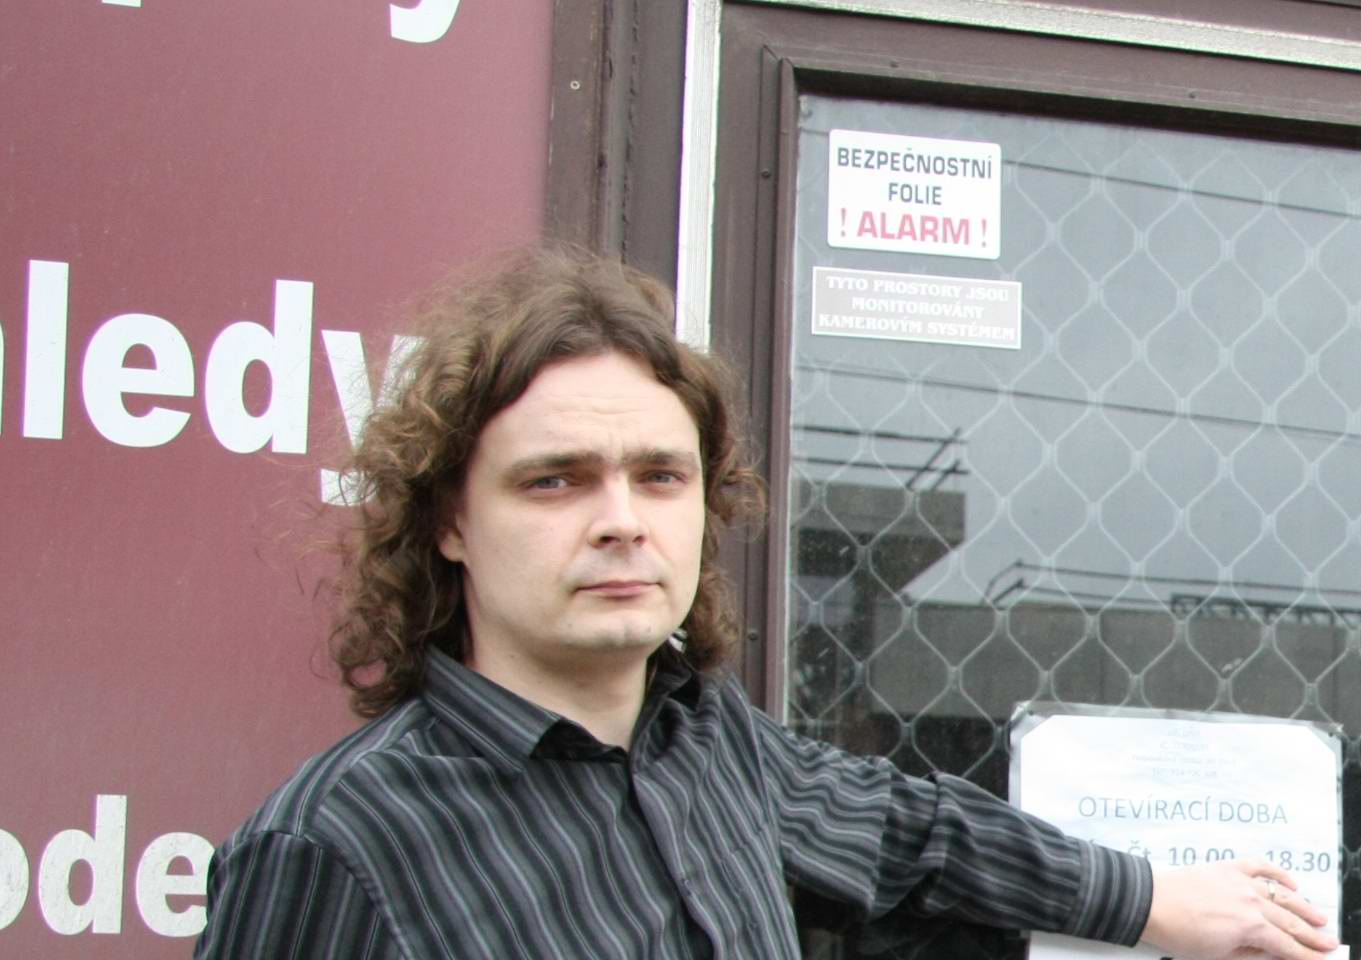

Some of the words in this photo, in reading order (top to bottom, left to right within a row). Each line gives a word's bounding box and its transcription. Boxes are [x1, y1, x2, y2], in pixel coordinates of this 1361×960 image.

[837, 147, 992, 179] BEZPEČNOSTNÍ
[888, 182, 942, 205] FOLIE
[856, 211, 970, 245] ALARM
[825, 275, 868, 291] TYTO
[873, 279, 963, 298] PROSTORY
[966, 287, 1009, 302] JSOU
[0, 259, 430, 506] ledy
[1078, 795, 1211, 821] OTEVÍRACÍ
[1219, 801, 1288, 825] DOBA
[1168, 847, 1235, 866] 1000
